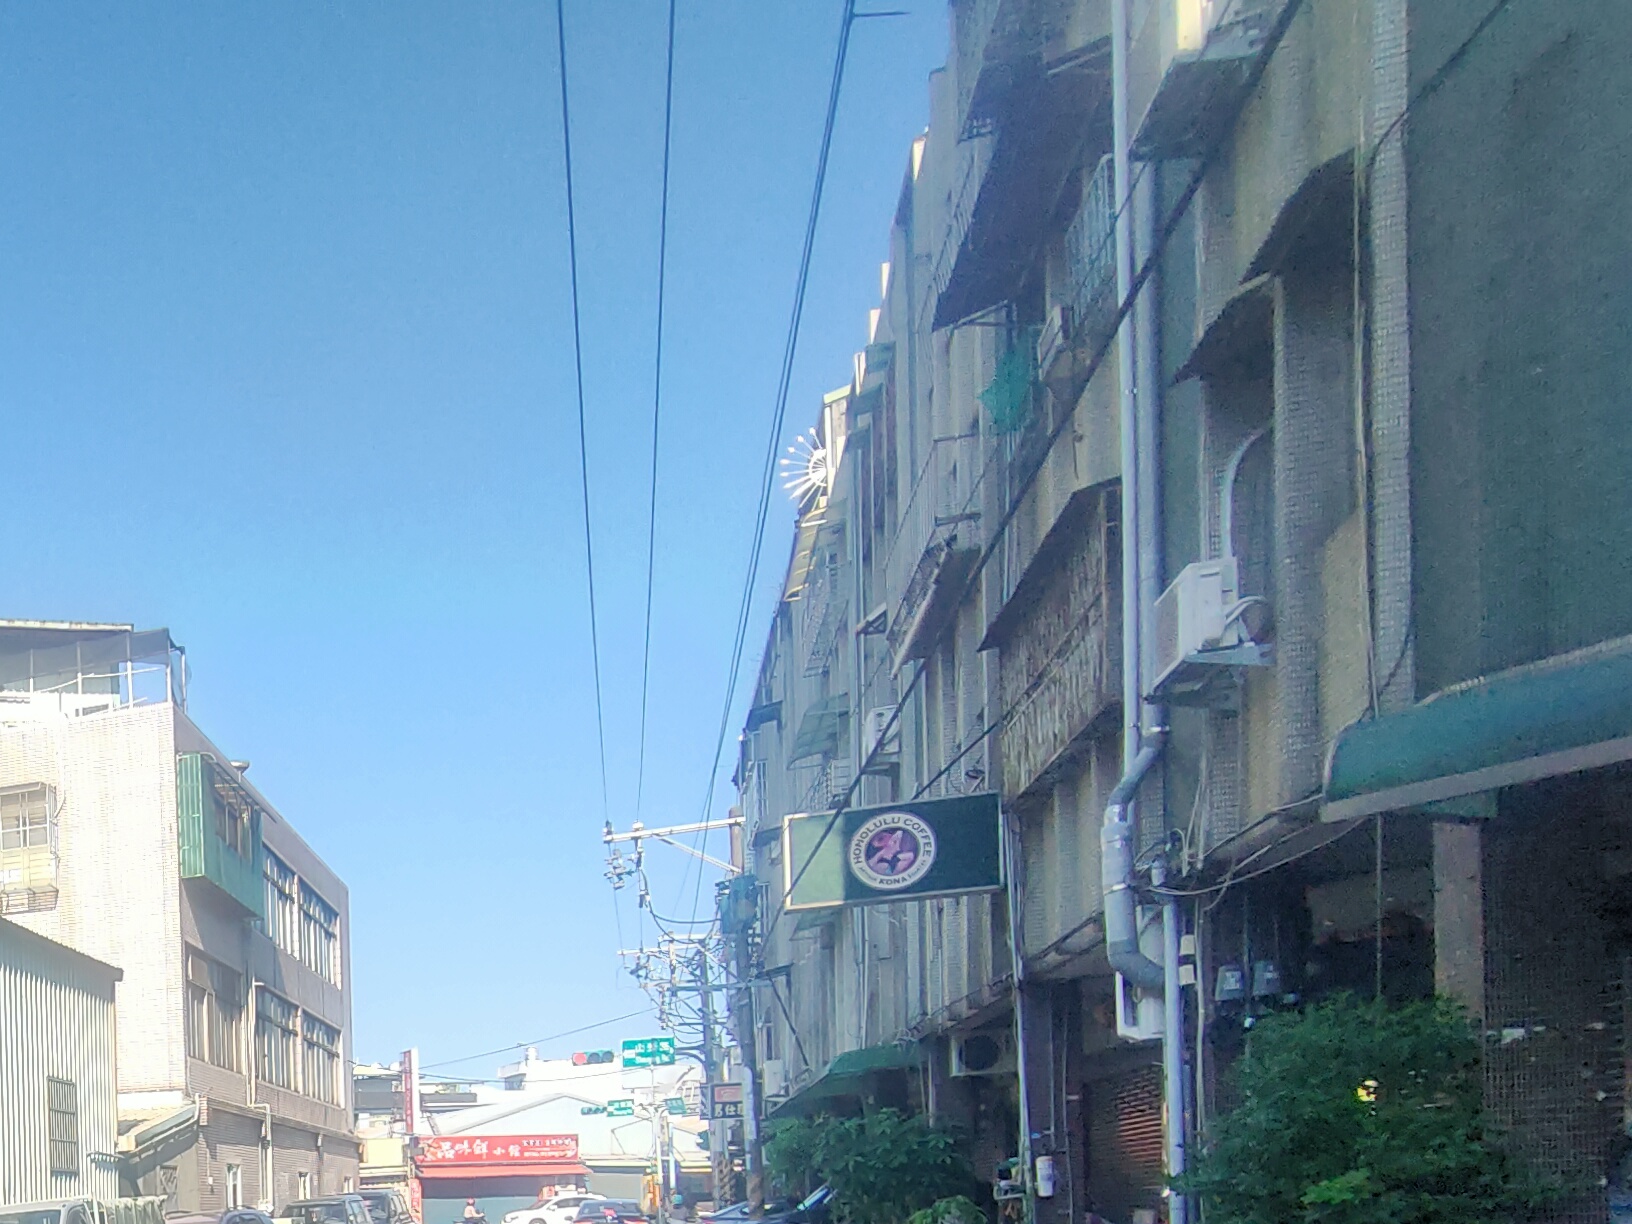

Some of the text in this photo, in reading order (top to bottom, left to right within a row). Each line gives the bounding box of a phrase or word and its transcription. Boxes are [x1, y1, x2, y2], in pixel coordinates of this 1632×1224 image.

[853, 816, 933, 865] HONOLULU COFFEE
[878, 876, 908, 886] KONA
